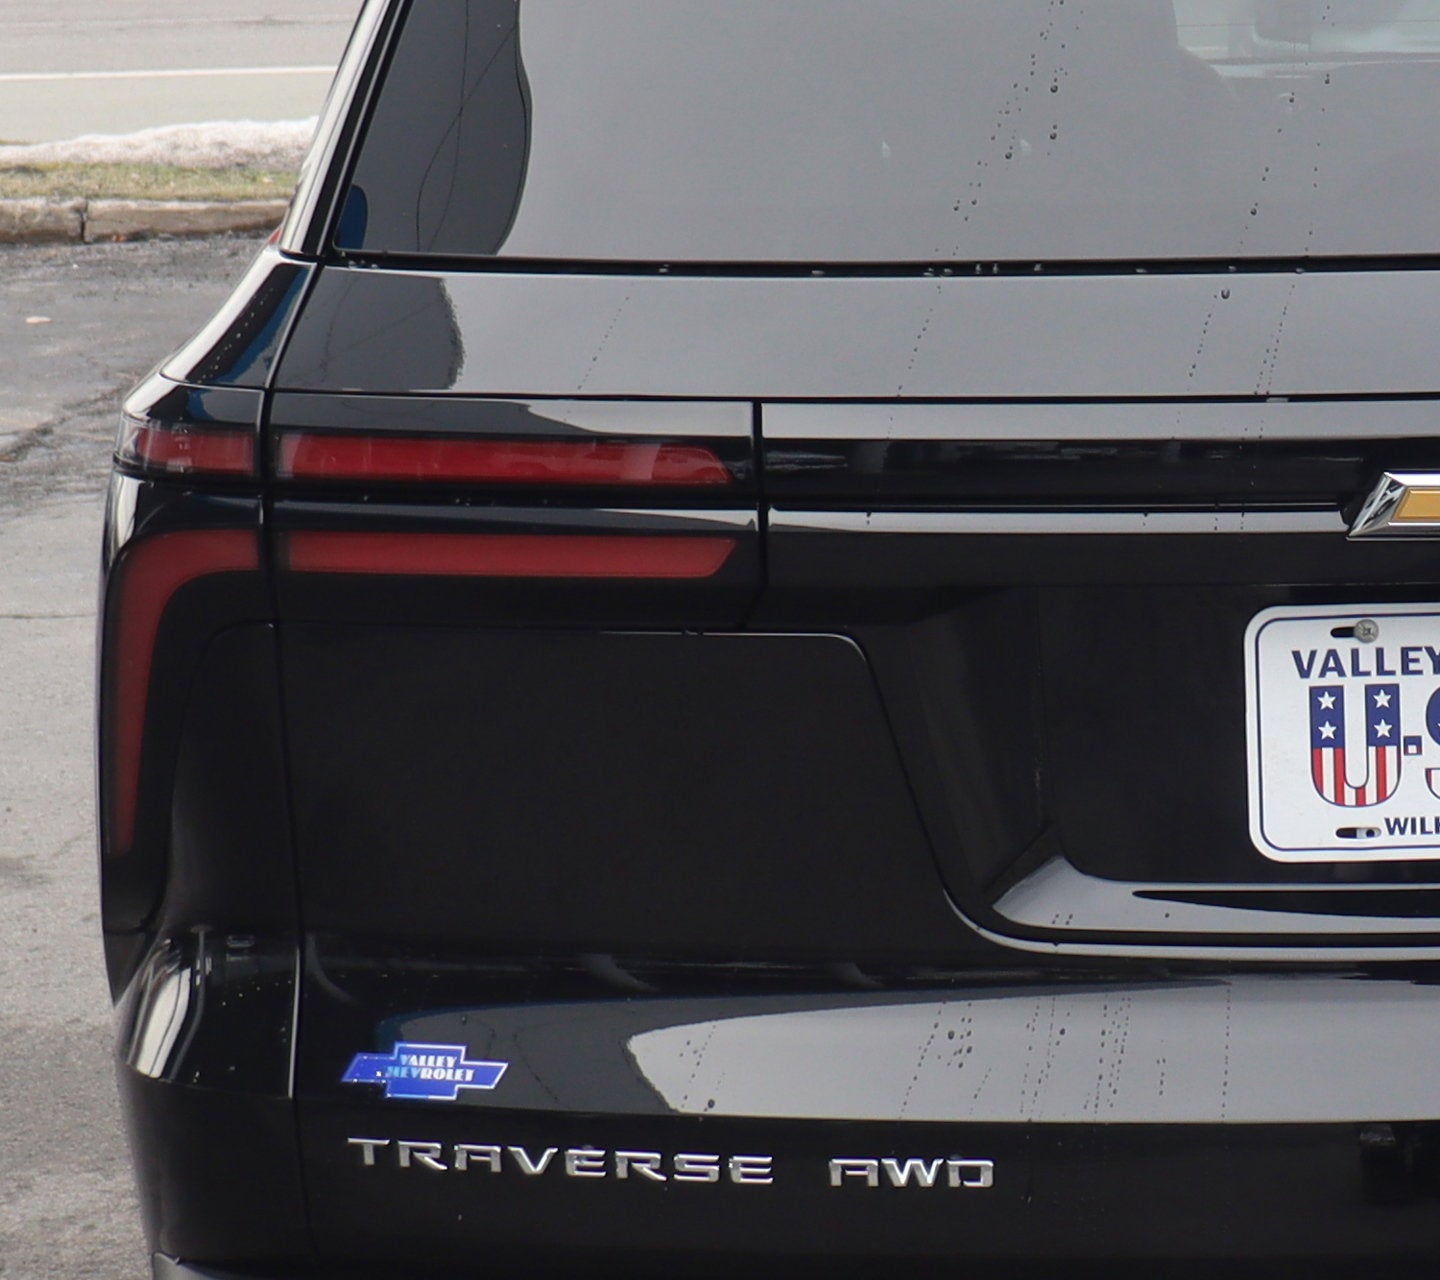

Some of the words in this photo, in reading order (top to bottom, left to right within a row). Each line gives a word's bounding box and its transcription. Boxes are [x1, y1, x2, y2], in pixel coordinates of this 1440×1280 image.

[400, 1053, 458, 1068] VALLEY
[382, 1066, 476, 1082] HEVROLET
[347, 1137, 774, 1184] TRAVERSE
[829, 1156, 995, 1188] AWD
